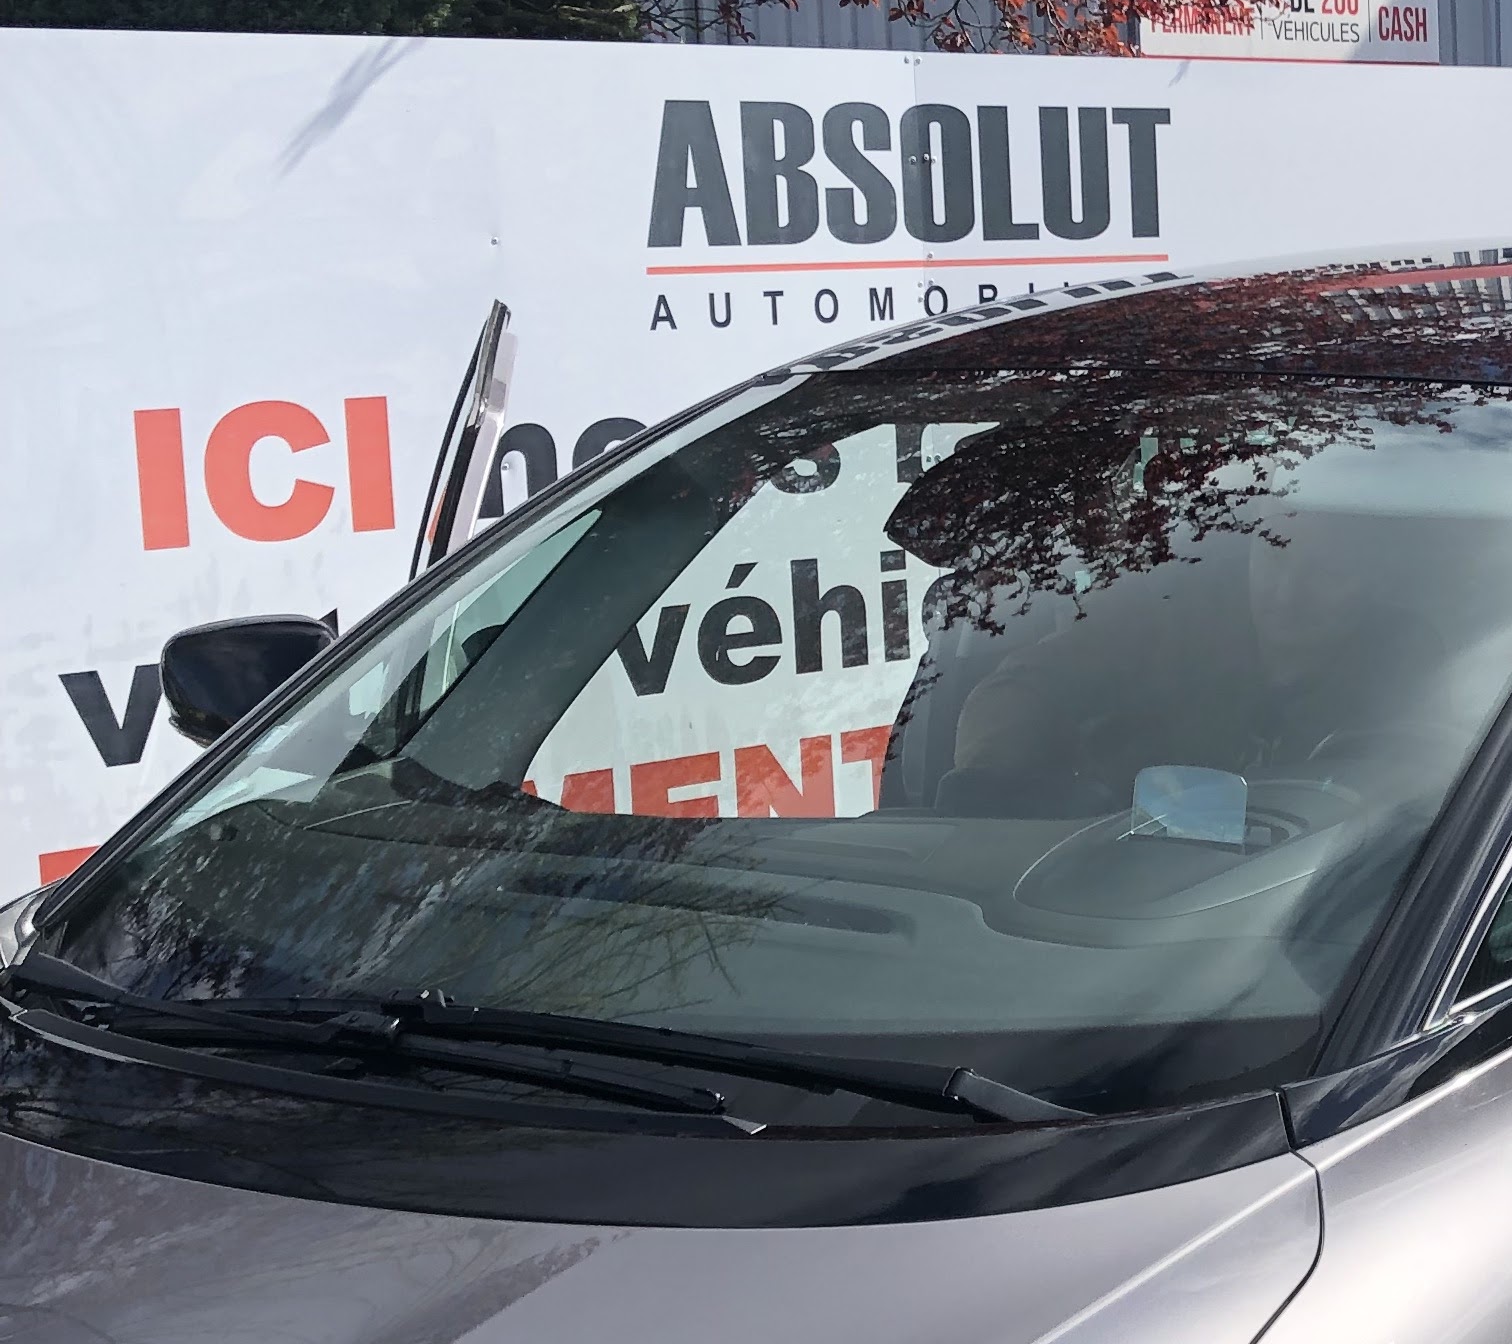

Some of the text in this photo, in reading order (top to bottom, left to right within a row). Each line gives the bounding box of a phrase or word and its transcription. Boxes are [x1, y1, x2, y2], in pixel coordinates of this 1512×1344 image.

[1271, 13, 1360, 43] VÉHICULES
[1377, 5, 1429, 43] CASH
[647, 99, 1171, 248] ABSOLUT
[649, 282, 1070, 332] AUTOMOB
[133, 395, 396, 552] ICI
